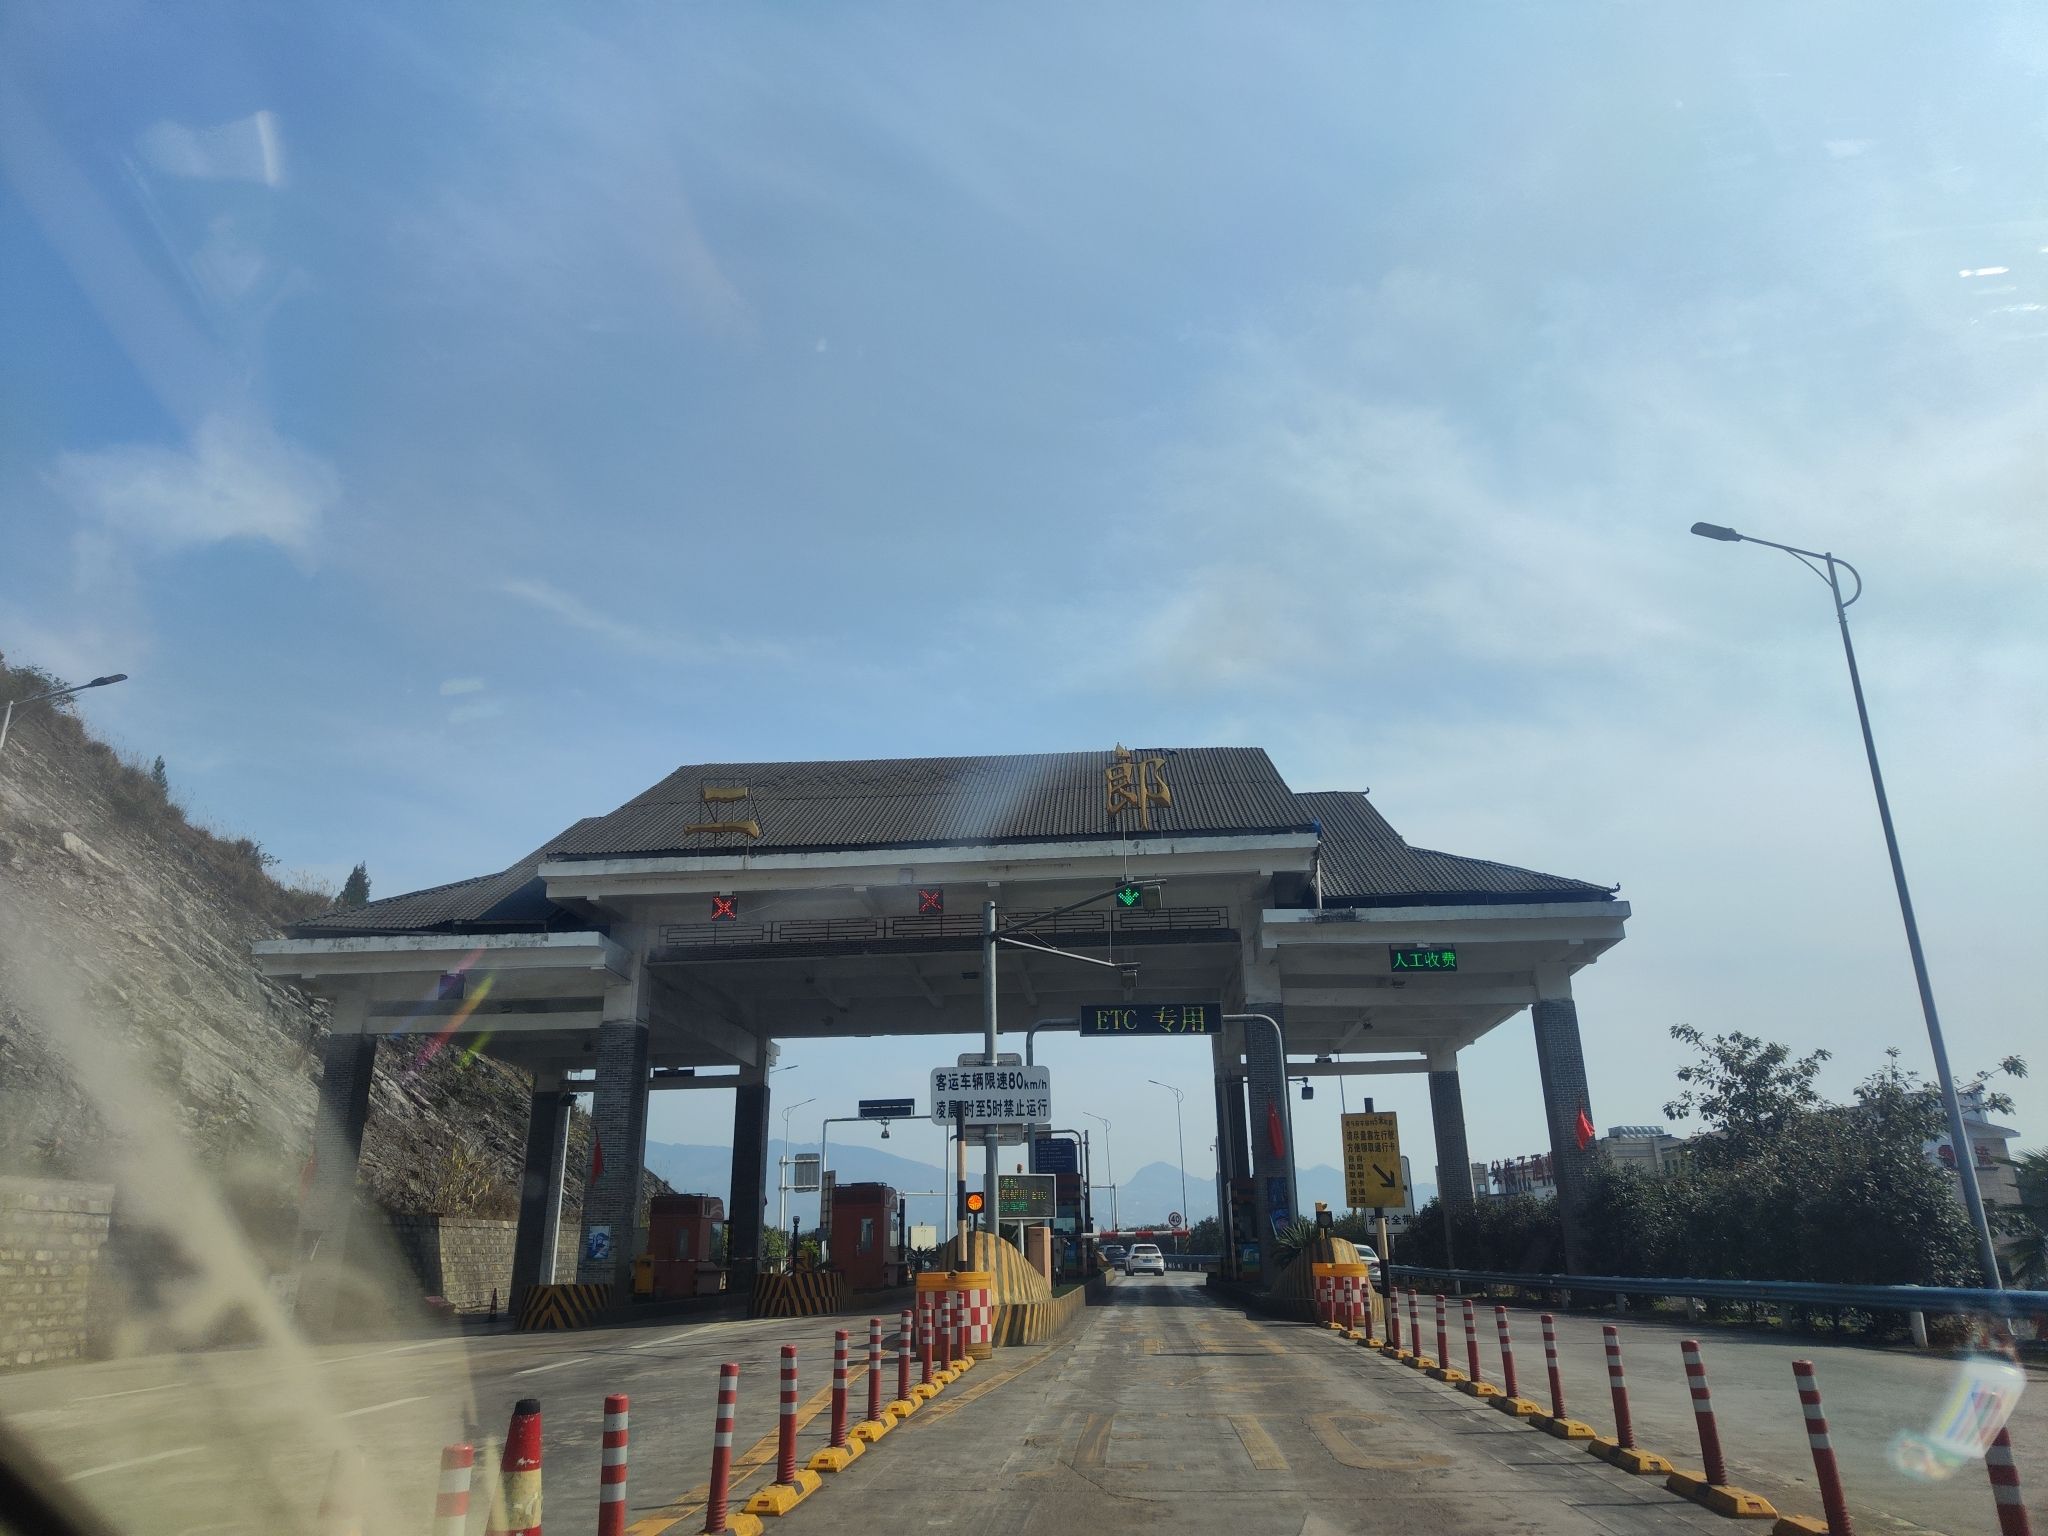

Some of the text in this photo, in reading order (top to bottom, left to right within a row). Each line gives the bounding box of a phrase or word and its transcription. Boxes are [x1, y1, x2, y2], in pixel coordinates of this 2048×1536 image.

[1105, 742, 1172, 831] 郎
[1393, 952, 1456, 968] 人工收费
[1096, 1006, 1206, 1032] ETC 专用
[936, 1071, 1047, 1091] 客运车辆限速80km/h
[936, 1099, 1047, 1119] 凌晨时至5时禁止运行
[1171, 1215, 1180, 1224] 40
